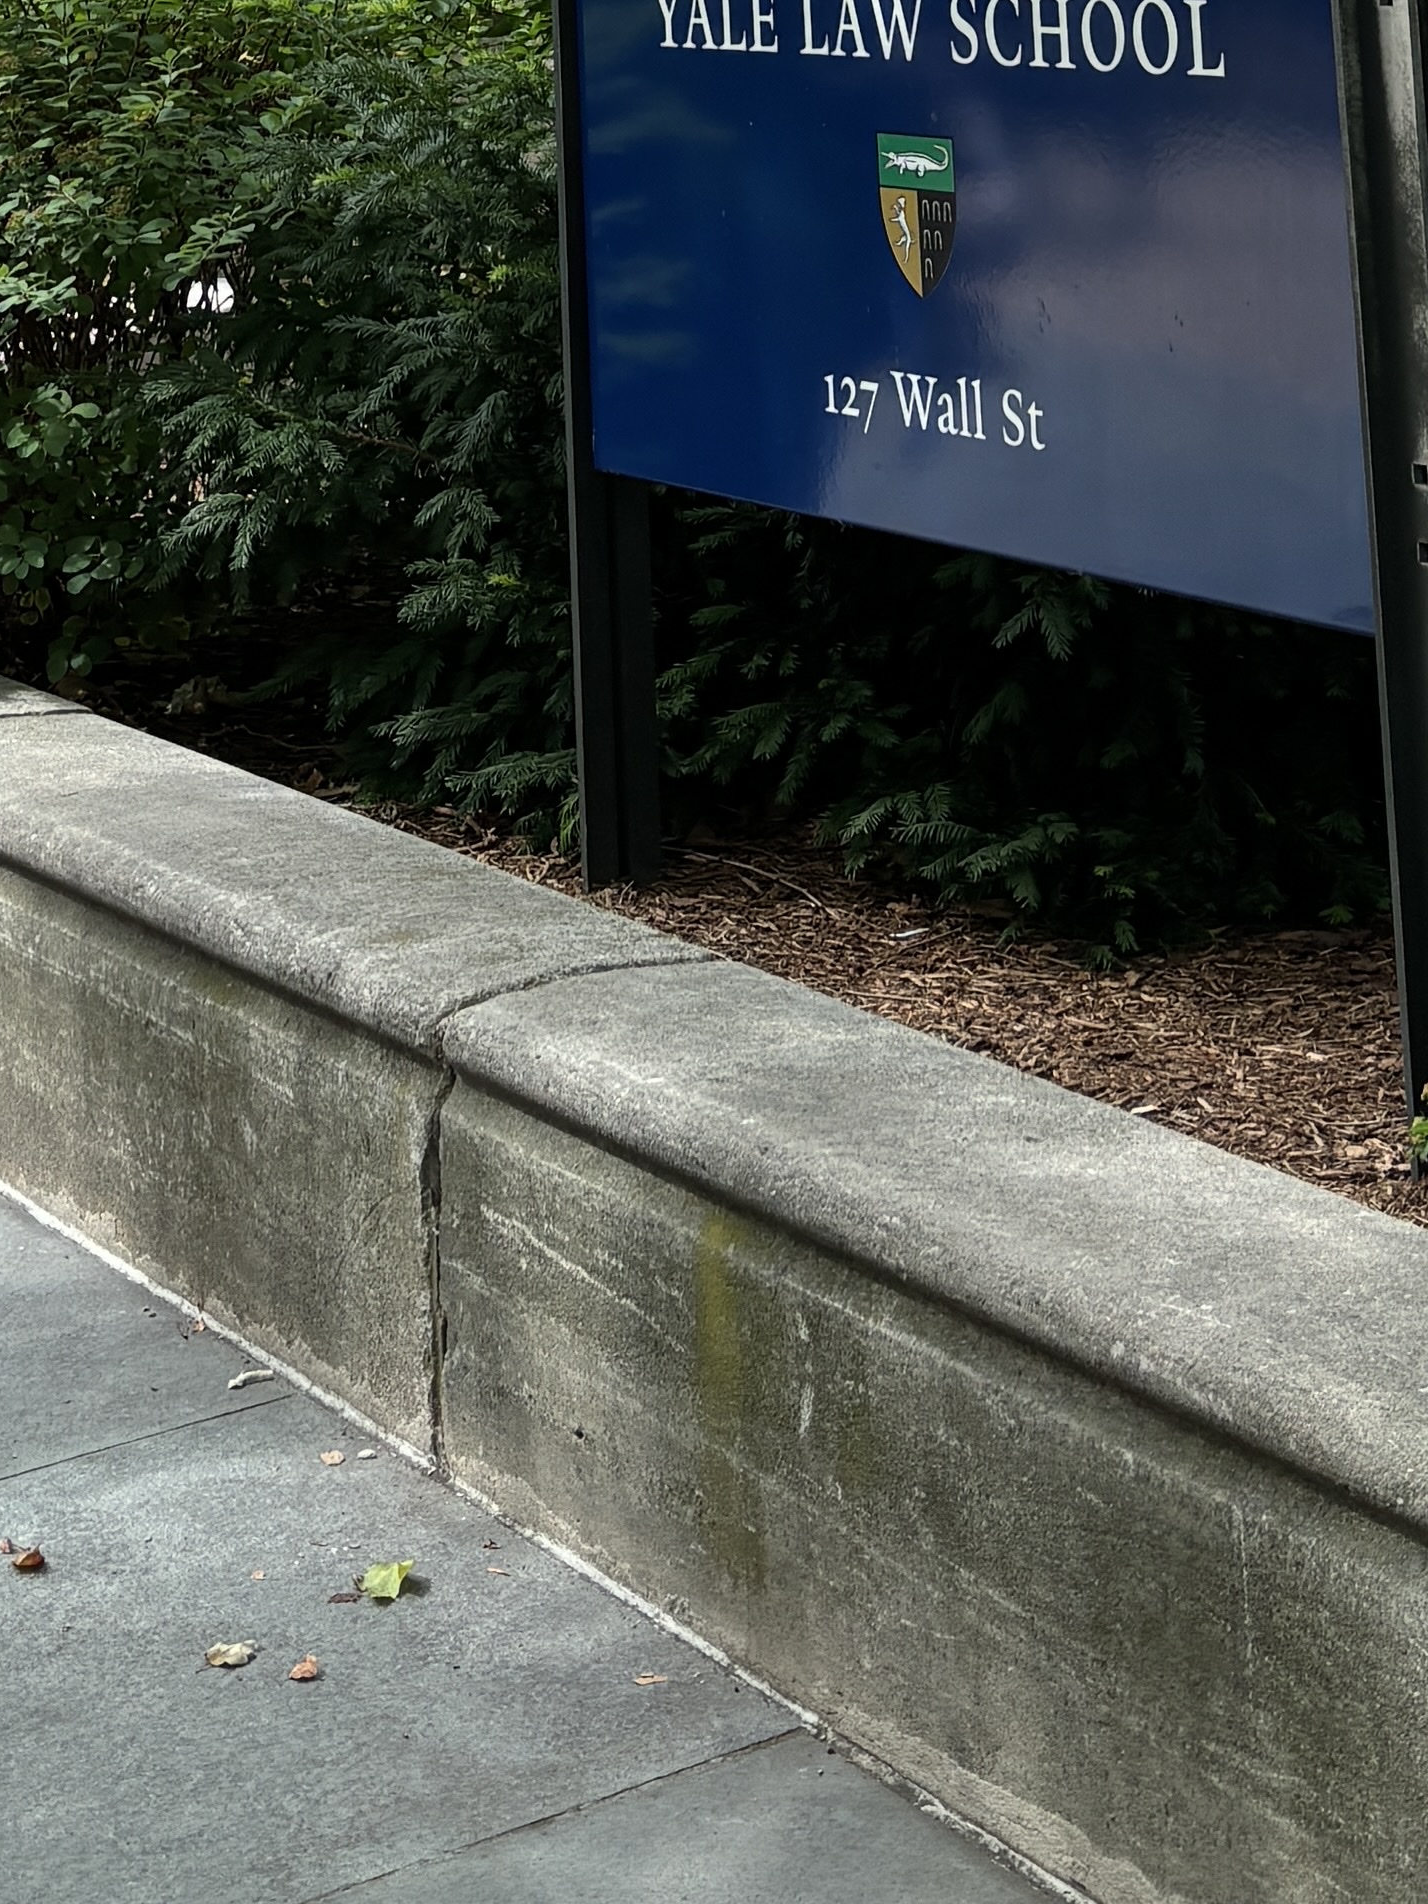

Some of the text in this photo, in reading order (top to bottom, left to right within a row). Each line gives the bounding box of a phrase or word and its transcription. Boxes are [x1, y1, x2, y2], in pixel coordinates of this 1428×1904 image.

[823, 369, 1047, 451] 127 Wall St
